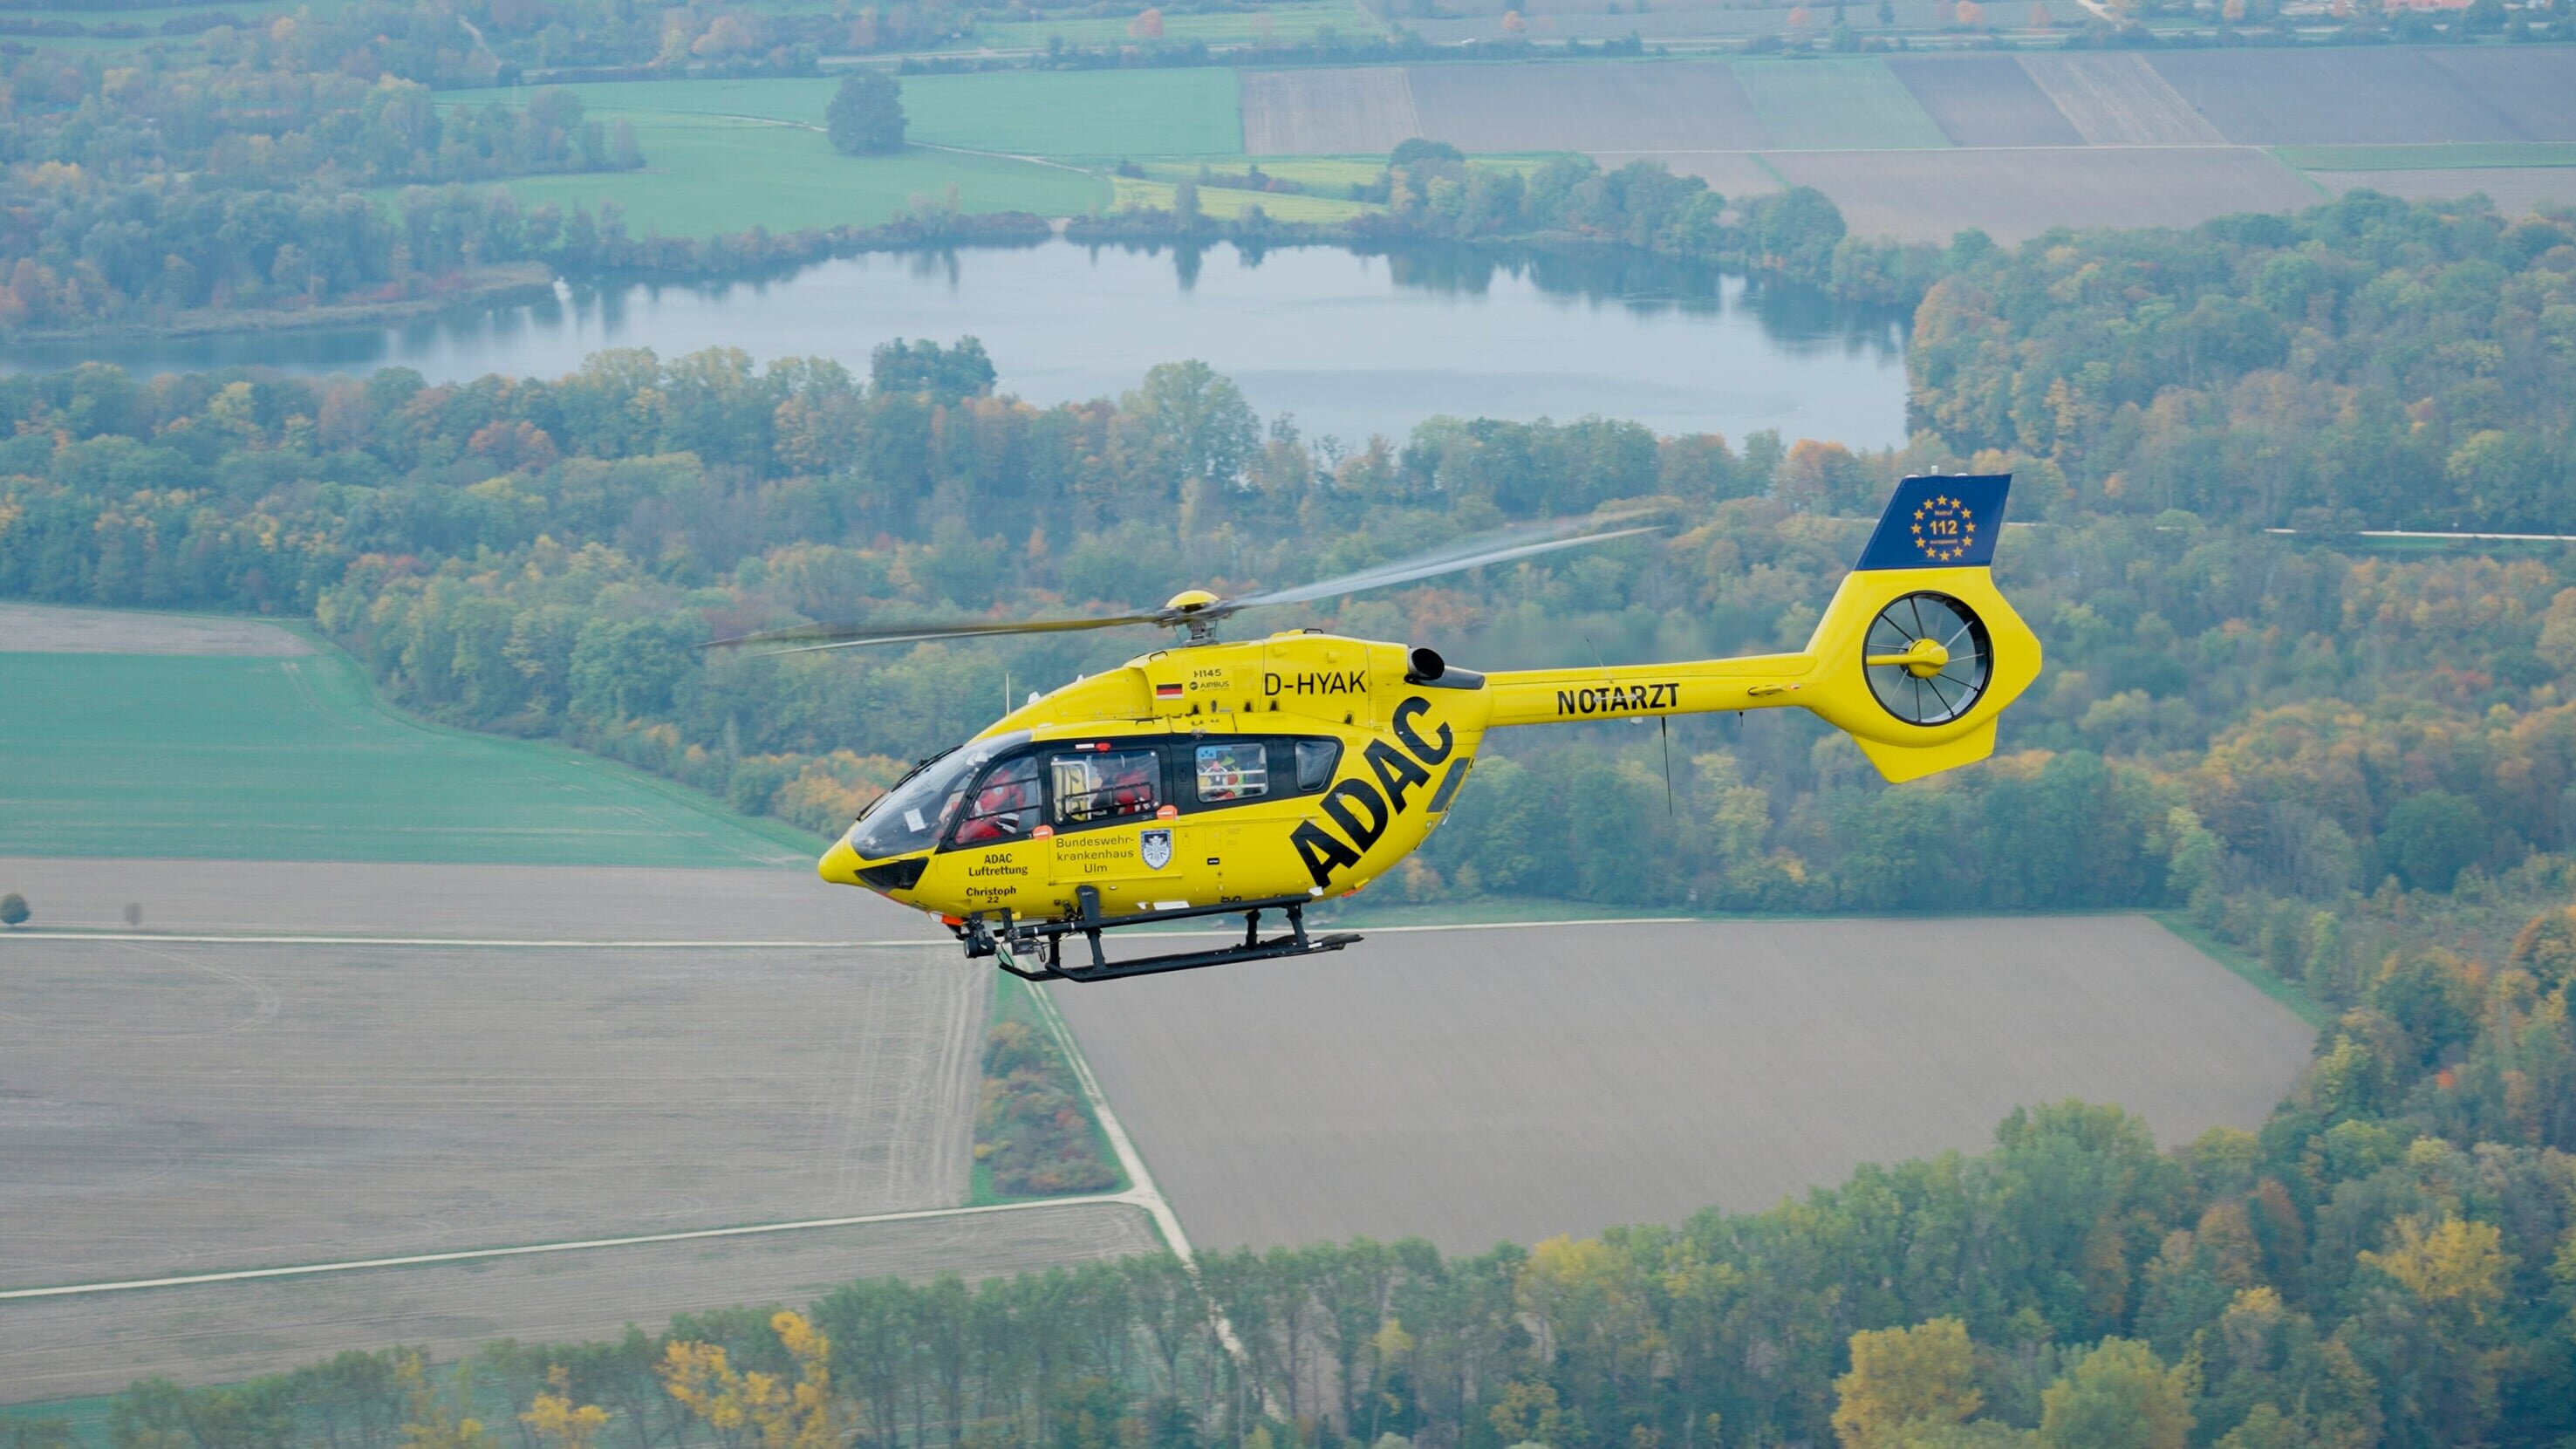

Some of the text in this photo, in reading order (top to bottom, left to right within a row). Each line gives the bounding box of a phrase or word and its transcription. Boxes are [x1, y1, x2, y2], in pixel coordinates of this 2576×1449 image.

[1930, 520, 1958, 535] 112
[1193, 669, 1222, 678] H145
[1200, 680, 1230, 689] AIRBUS
[1264, 670, 1367, 696] D-HYAK
[1557, 682, 1680, 715] NOTARZT
[1289, 696, 1453, 889] ADAC
[1056, 835, 1135, 848] Bundeswehr-
[984, 853, 1013, 864] ADAC
[1056, 848, 1135, 862] krankenhaus
[968, 865, 1028, 877] Luftrettung
[1083, 863, 1108, 873] Ulm
[966, 885, 1016, 897] Christoph
